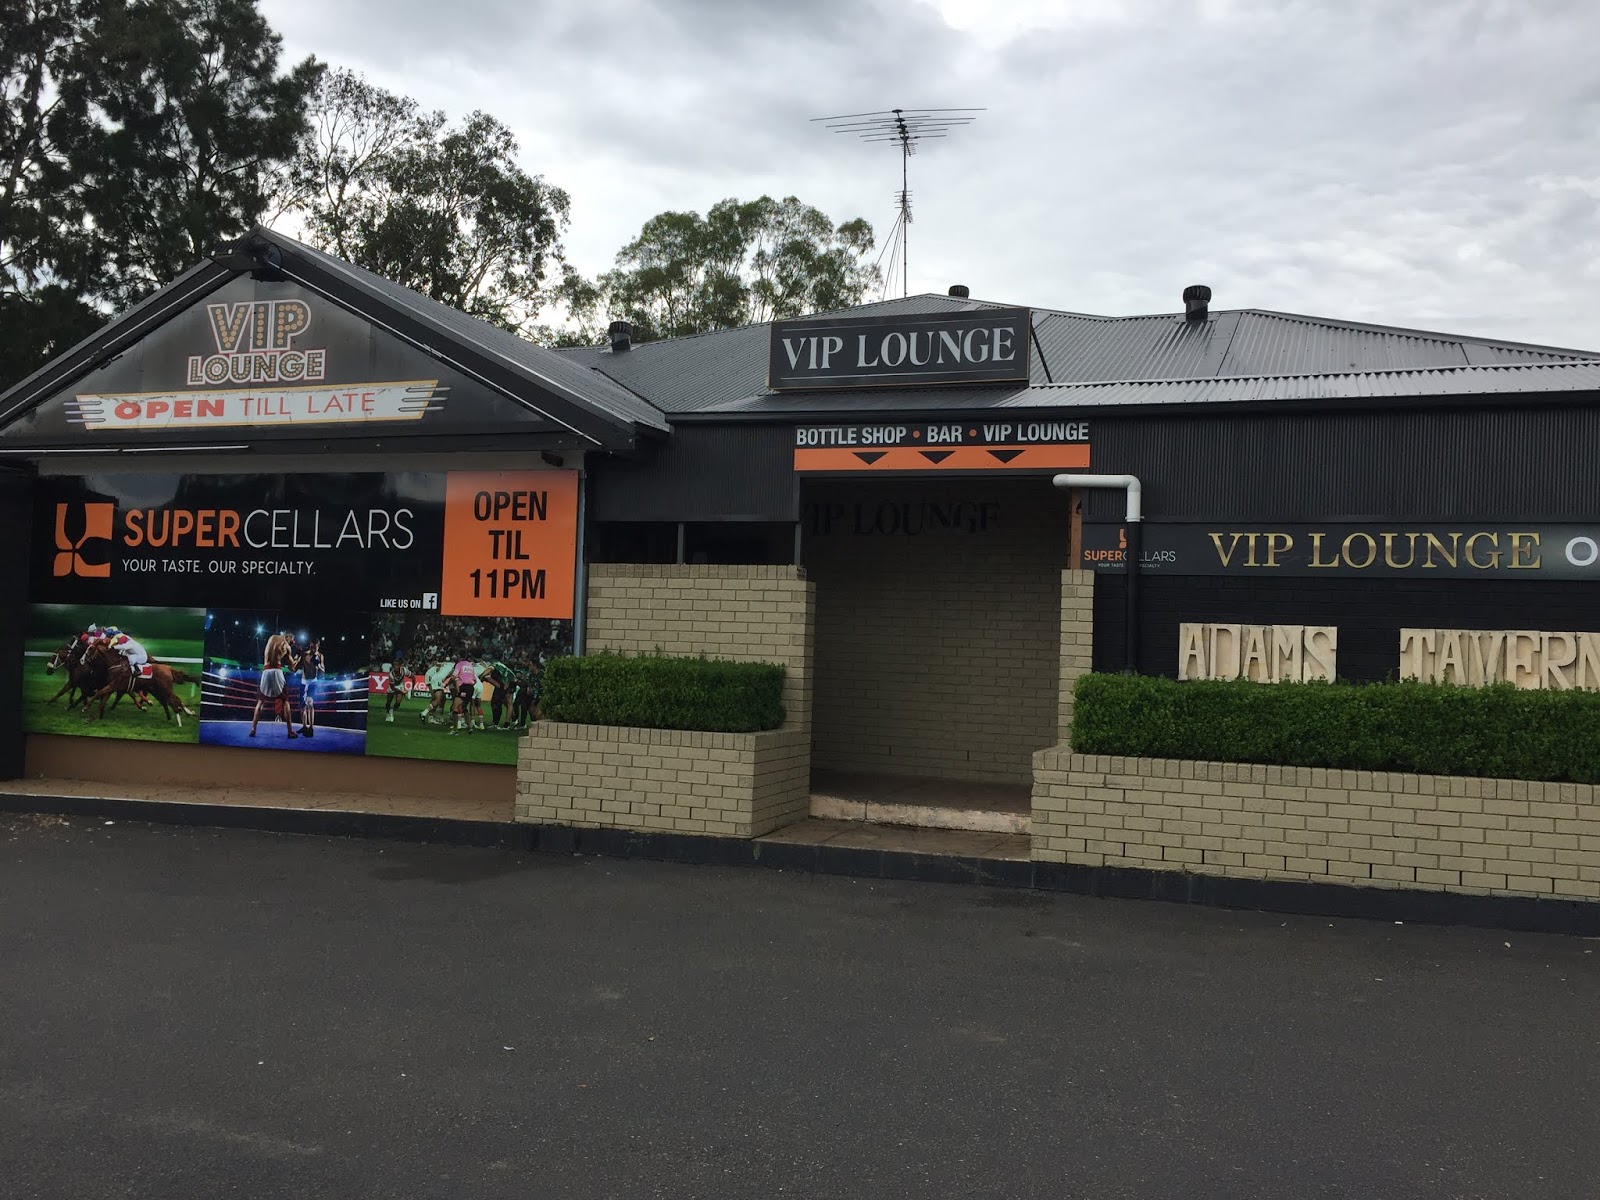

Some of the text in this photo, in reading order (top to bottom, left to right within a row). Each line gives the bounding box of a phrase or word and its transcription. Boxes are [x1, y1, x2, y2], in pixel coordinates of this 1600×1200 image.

[207, 299, 311, 353] VIP
[782, 327, 1016, 370] VIP LOUNGE
[186, 349, 326, 386] LOUNGE
[114, 392, 376, 420] OPEN TILL LATE
[796, 422, 1089, 446] BOTTLE SHOP BAR VIP LOUNGE
[474, 491, 548, 521] OPEN
[123, 508, 414, 550] SUPERCELLARS
[488, 530, 530, 560] TIL
[1208, 532, 1294, 567] VIP
[1307, 532, 1542, 569] LOUNGE
[122, 558, 316, 575] YOUR TASTE. OUR SPECIALTY.
[470, 569, 546, 599] 11PM
[380, 599, 397, 608] LIKE
[398, 599, 409, 608] US
[410, 599, 421, 609] ON
[1179, 623, 1337, 685] ADAMS
